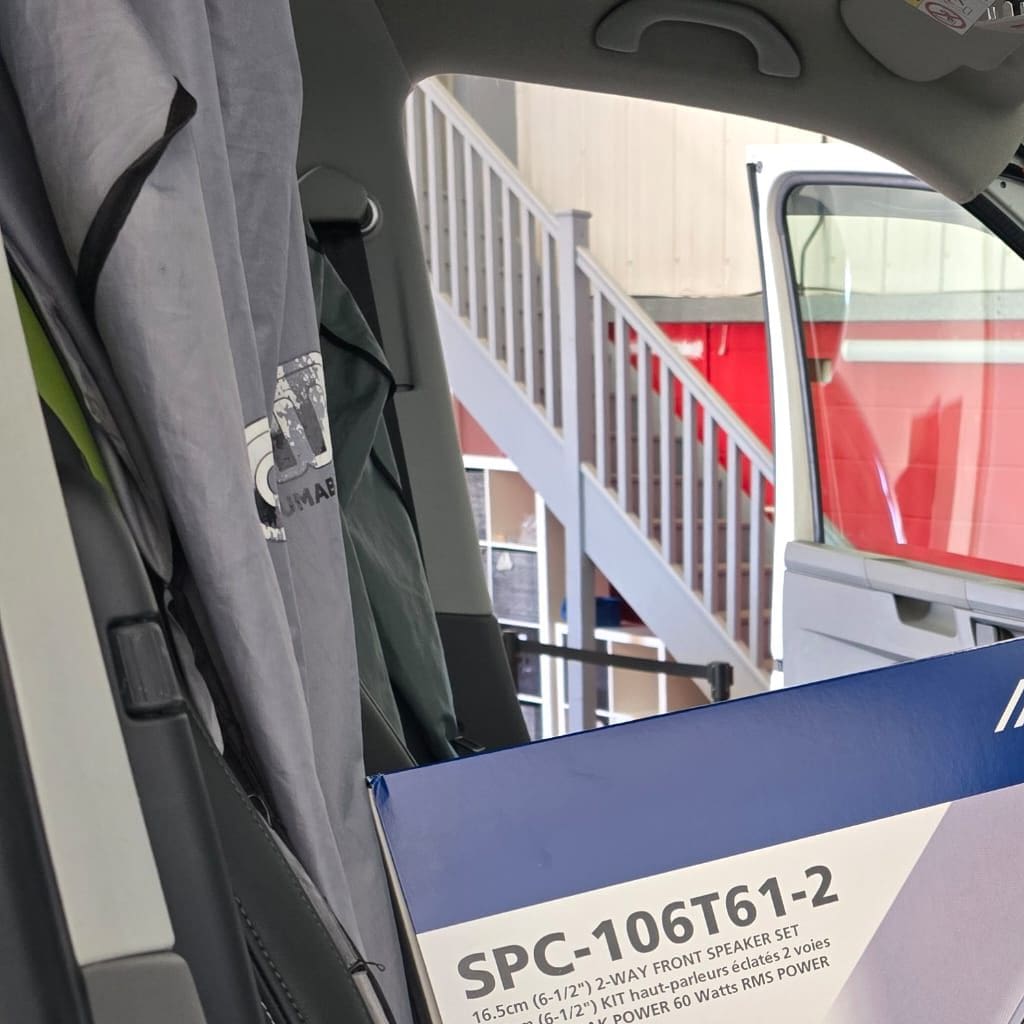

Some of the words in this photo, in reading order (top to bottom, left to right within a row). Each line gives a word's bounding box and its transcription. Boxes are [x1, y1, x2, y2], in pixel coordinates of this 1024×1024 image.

[456, 864, 840, 1001] SPC-106T61-2
[472, 1000, 530, 1024] 16.5cm
[594, 964, 648, 991] 2-WAY
[652, 950, 702, 975] FRONT
[706, 932, 772, 960] SPEAKER
[774, 923, 800, 942] SET
[600, 991, 626, 1010] KIT
[628, 965, 730, 1002] haut-parleurs
[731, 951, 781, 973] éclatés
[782, 946, 792, 960] 2
[793, 937, 831, 956] voies
[673, 994, 692, 1010] 60
[694, 982, 739, 1004] Watts
[741, 970, 774, 991] RMS
[777, 955, 831, 981] POWER
